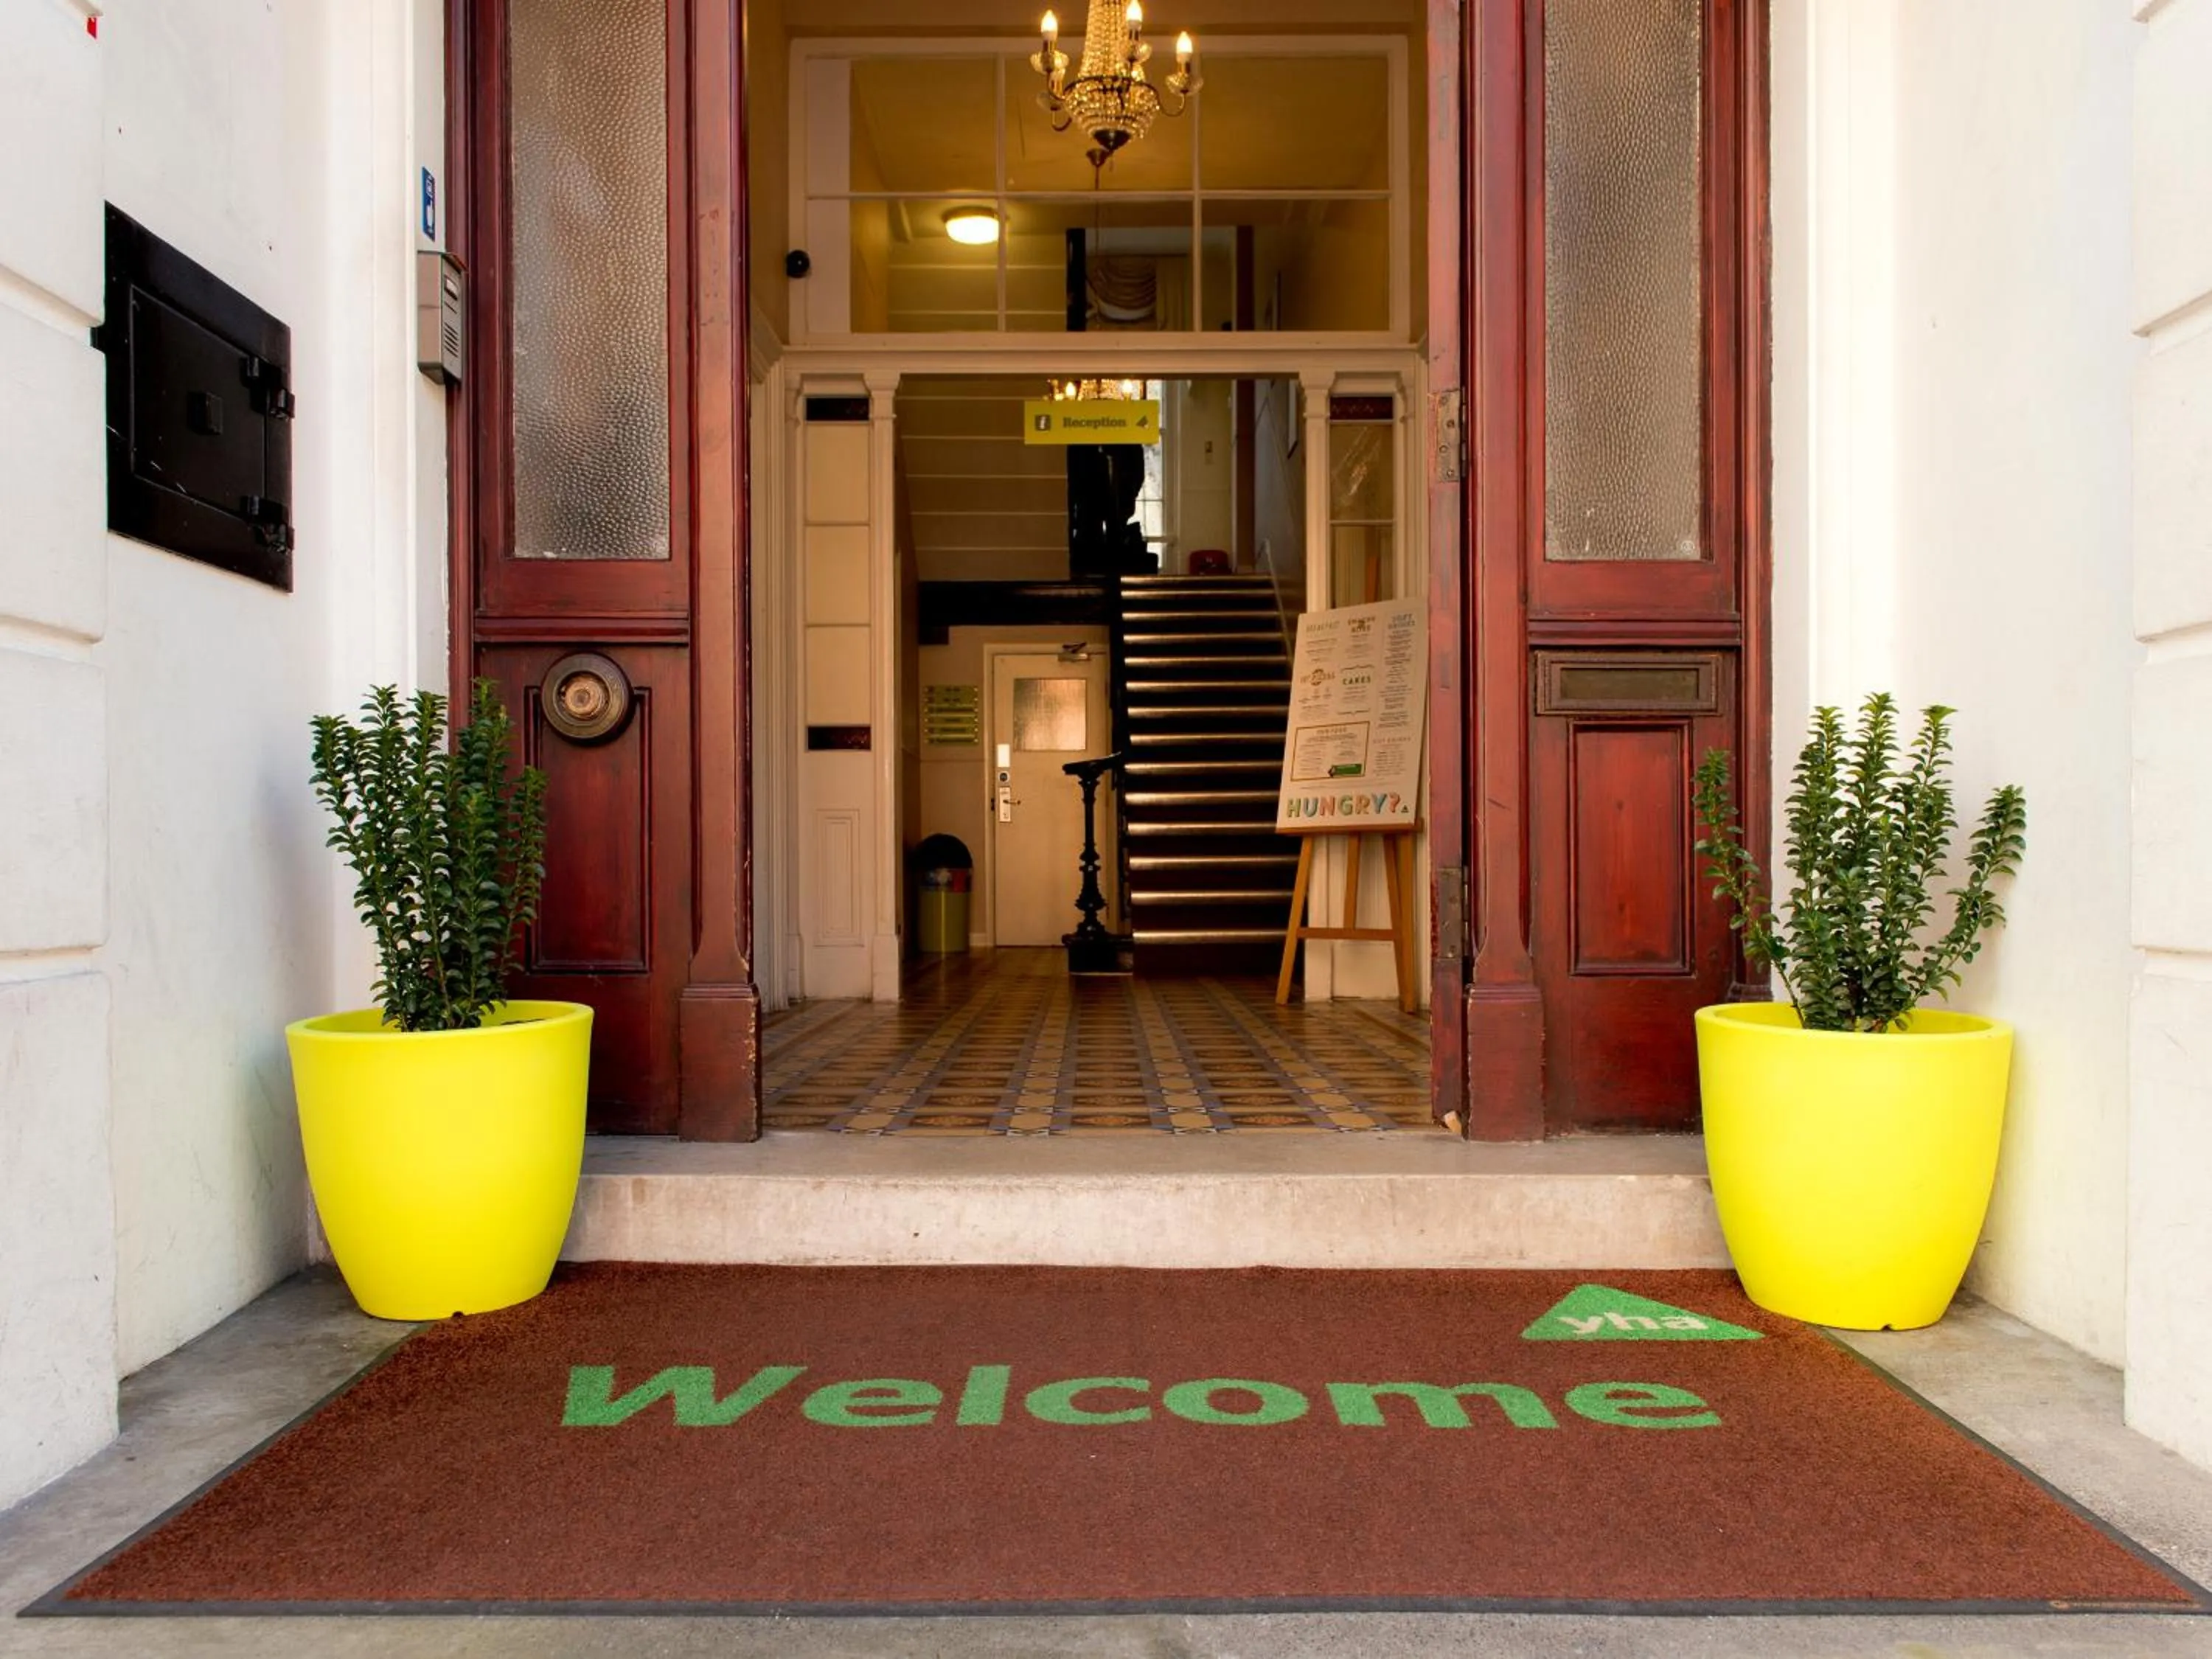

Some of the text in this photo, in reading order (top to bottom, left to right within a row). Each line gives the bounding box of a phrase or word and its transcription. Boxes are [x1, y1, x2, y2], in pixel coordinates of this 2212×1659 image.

[1062, 416, 1127, 429] Reception
[1342, 675, 1371, 686] CAKES
[1287, 791, 1402, 818] HUNGRY?
[1556, 1312, 1710, 1335] yha
[561, 1364, 1722, 1429] Welcome
